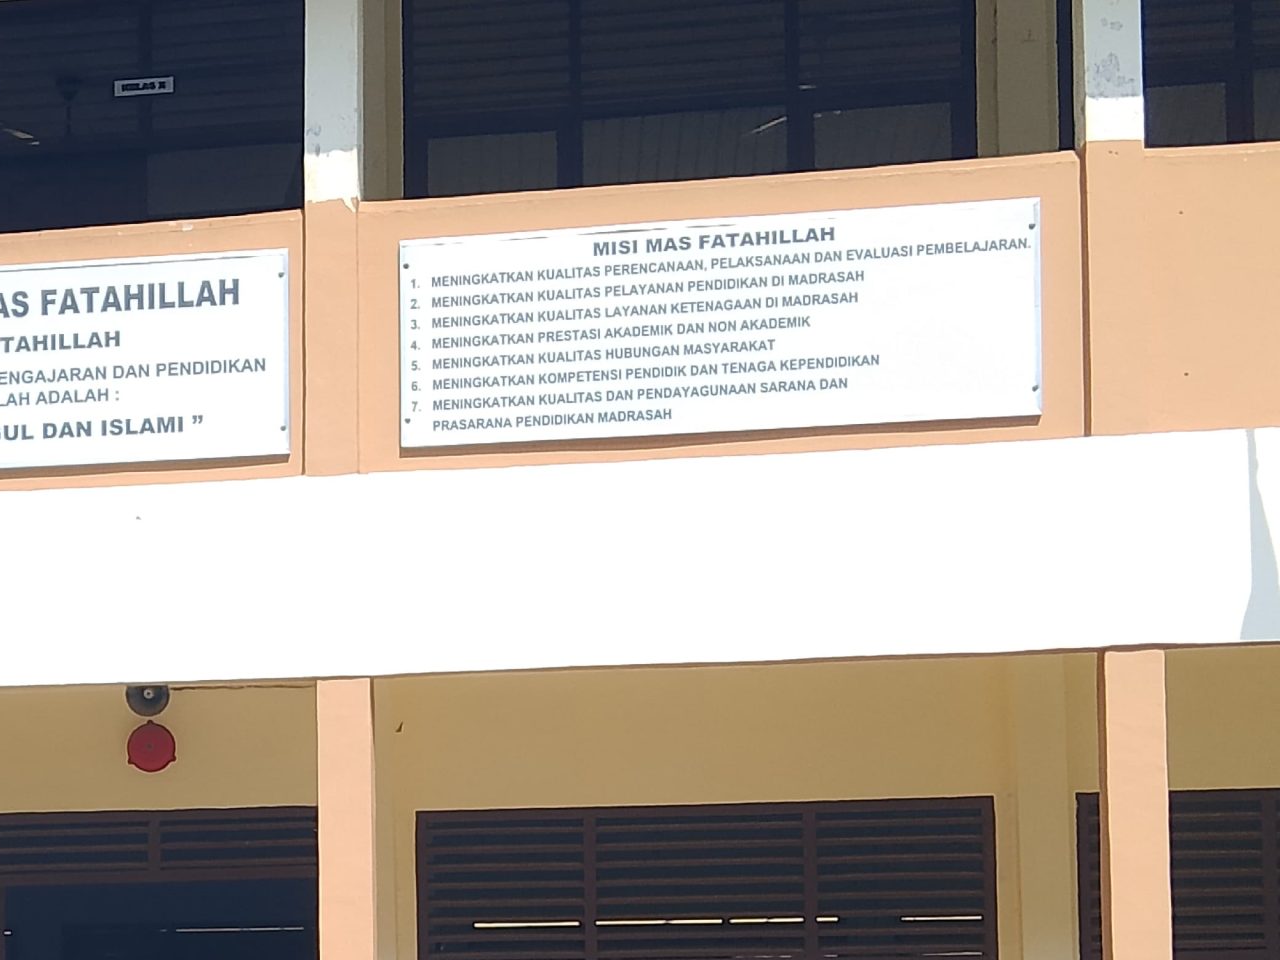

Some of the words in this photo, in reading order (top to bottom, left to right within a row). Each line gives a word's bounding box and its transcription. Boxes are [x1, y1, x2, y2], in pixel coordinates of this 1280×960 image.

[594, 240, 637, 256] MISI
[646, 237, 691, 253] MAS
[699, 227, 835, 249] FATAHILLAH
[411, 279, 420, 289] 1.
[432, 271, 533, 287] MENINGKATKAN
[538, 266, 600, 280] KUALITAS
[605, 259, 707, 276] PERENCANAAN,
[711, 253, 810, 269] PELAKSANAAN
[815, 251, 842, 263] DAN
[847, 245, 912, 261] EVALUASI
[917, 238, 1031, 256] PEMBELAJARAN.
[41, 279, 239, 316] FATAHILLAH
[410, 299, 420, 309] 2.
[432, 291, 533, 308] MENINGKATKAN
[538, 287, 600, 301] KUALITAS
[605, 282, 683, 297] PELAYANAN
[688, 277, 767, 292] PENDIDIKAN
[772, 275, 784, 286] DI
[789, 270, 864, 285] MADRASAH
[410, 319, 420, 330] 3.
[432, 312, 533, 328] MENINGKATKAN
[538, 307, 601, 322] KUALITAS
[605, 304, 666, 318] LAYANAN
[671, 298, 761, 314] KETENAGAAN
[766, 297, 778, 308] DI
[782, 292, 858, 307] MADRASAH
[410, 339, 420, 350] 4.
[432, 333, 533, 349] MENINGKATKAN
[538, 328, 600, 343] PRESTASI
[604, 324, 673, 339] AKADEMIK
[677, 323, 704, 334] DAN
[709, 320, 736, 332] NON
[740, 316, 811, 331] AKADEMIK
[113, 364, 149, 379] DAN
[156, 358, 266, 377] PENDIDIKAN
[411, 360, 421, 371] 5.
[432, 354, 534, 369] MENINGKATKAN
[539, 350, 601, 364] KUALITAS
[606, 345, 679, 360] HUBUNGAN
[684, 339, 776, 355] MASYARAKAT
[411, 381, 421, 391] 6.
[433, 374, 534, 390] MENINGKATKAN
[539, 369, 621, 384] KOMPETENSI
[626, 365, 687, 380] PENDIDIK
[691, 364, 717, 376] DAN
[721, 361, 776, 374] TENAGA
[780, 354, 879, 371] KEPENDIDIKAN
[35, 388, 108, 405] ADALAH
[412, 401, 422, 412] 7.
[433, 395, 534, 411] MENINGKATKAN
[539, 391, 602, 405] KUALITAS
[606, 389, 633, 401] DAN
[637, 383, 756, 400] PENDAYAGUNAAN
[760, 380, 816, 393] SARANA
[820, 378, 848, 390] DAN
[43, 421, 92, 439] DAN
[101, 416, 183, 436] ISLAMI
[433, 417, 512, 431] PRASARANA
[516, 413, 594, 428] PENDIDIKAN
[598, 408, 672, 423] MADRASAH
